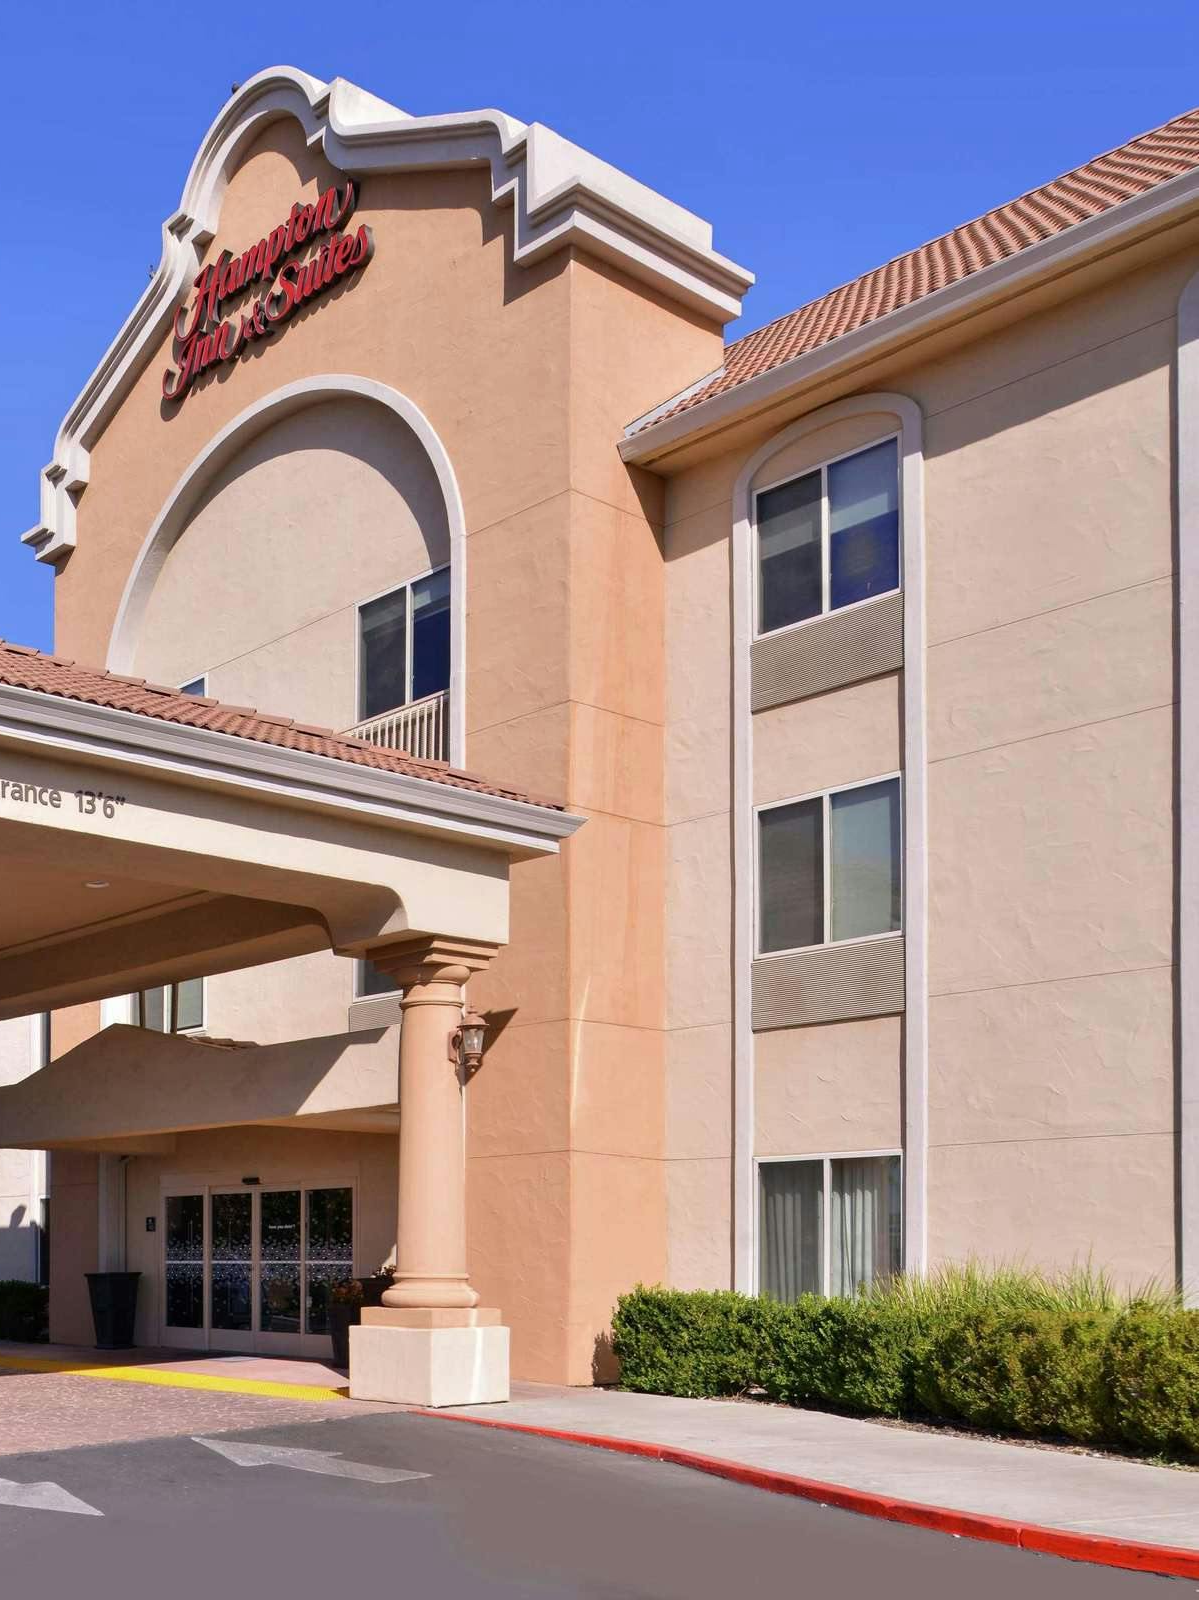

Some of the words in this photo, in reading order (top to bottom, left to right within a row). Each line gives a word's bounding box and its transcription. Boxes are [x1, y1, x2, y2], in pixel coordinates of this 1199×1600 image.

[162, 315, 244, 400] Inn
[244, 300, 265, 341] &
[265, 224, 371, 321] Suites
[174, 179, 355, 342] Hampton
[74, 790, 126, 819] 13'6"
